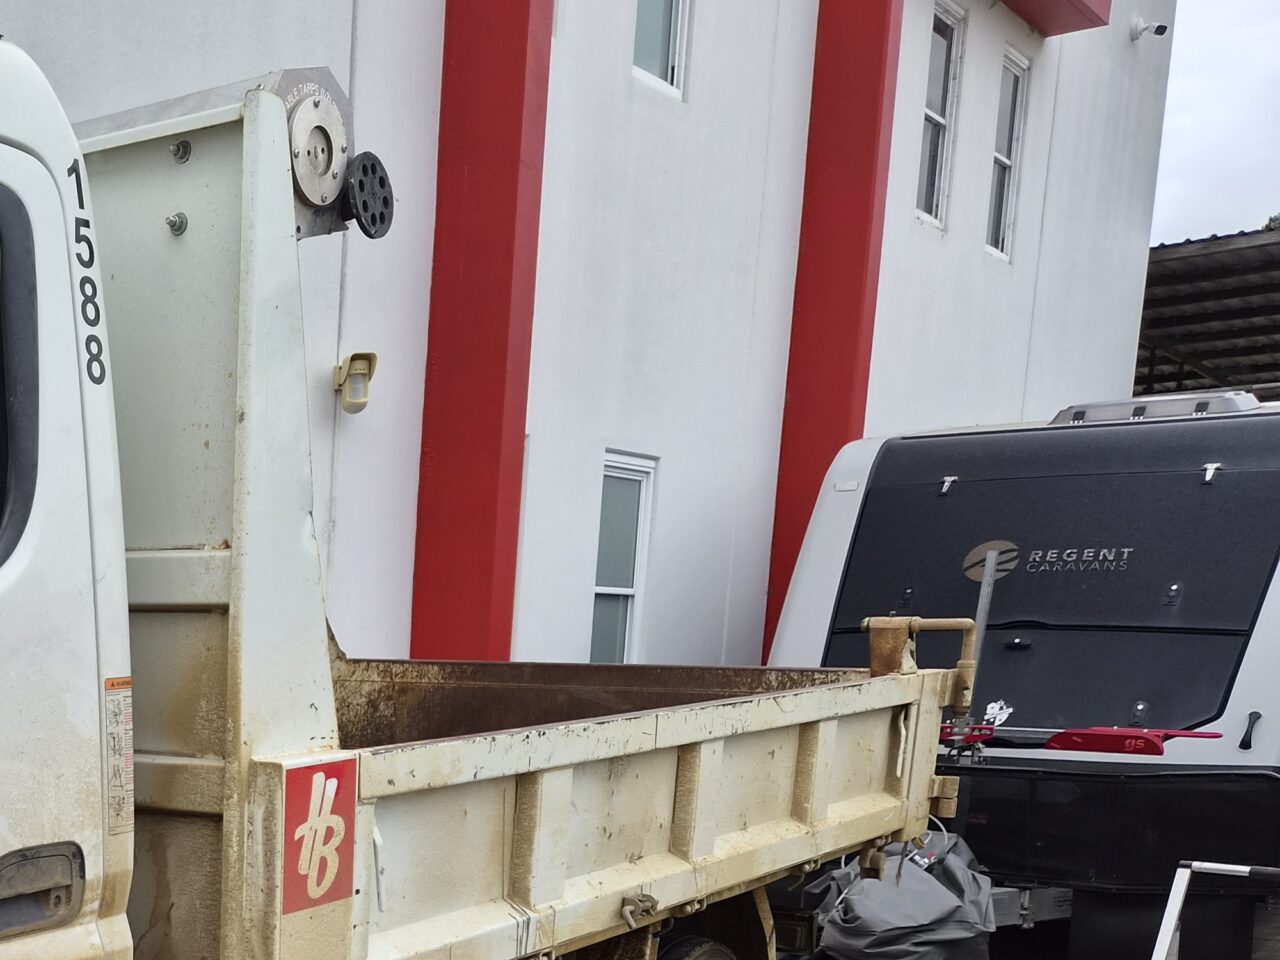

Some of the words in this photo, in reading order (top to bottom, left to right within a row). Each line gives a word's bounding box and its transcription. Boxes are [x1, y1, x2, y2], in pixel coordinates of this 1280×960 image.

[66, 157, 107, 387] 1588
[1028, 547, 1135, 562] REGENT
[1025, 559, 1129, 573] CARAVANS
